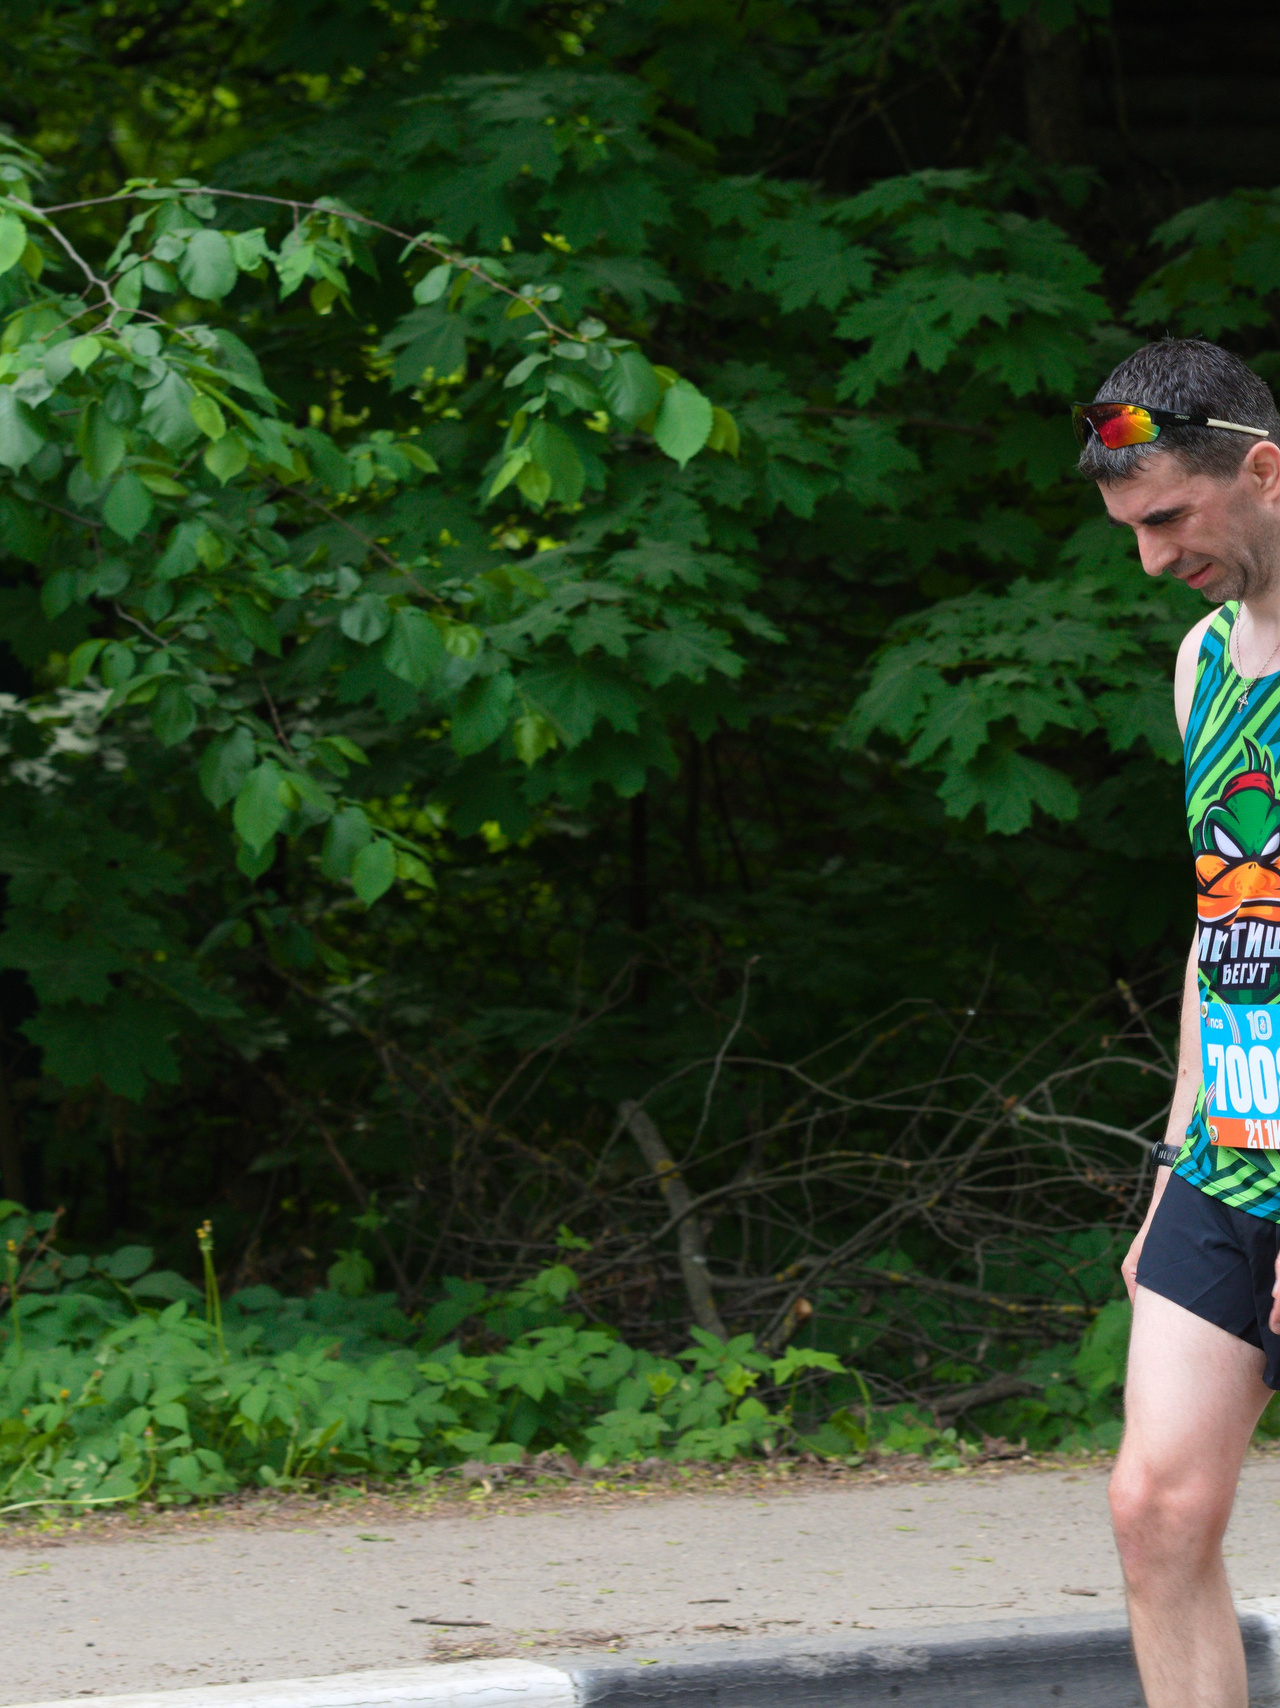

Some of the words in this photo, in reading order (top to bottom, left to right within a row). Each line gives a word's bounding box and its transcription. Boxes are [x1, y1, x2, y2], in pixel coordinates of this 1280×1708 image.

[1222, 962, 1270, 985] БЕГУТ
[1210, 1017, 1224, 1029] ПСБ
[1245, 1010, 1273, 1040] 10
